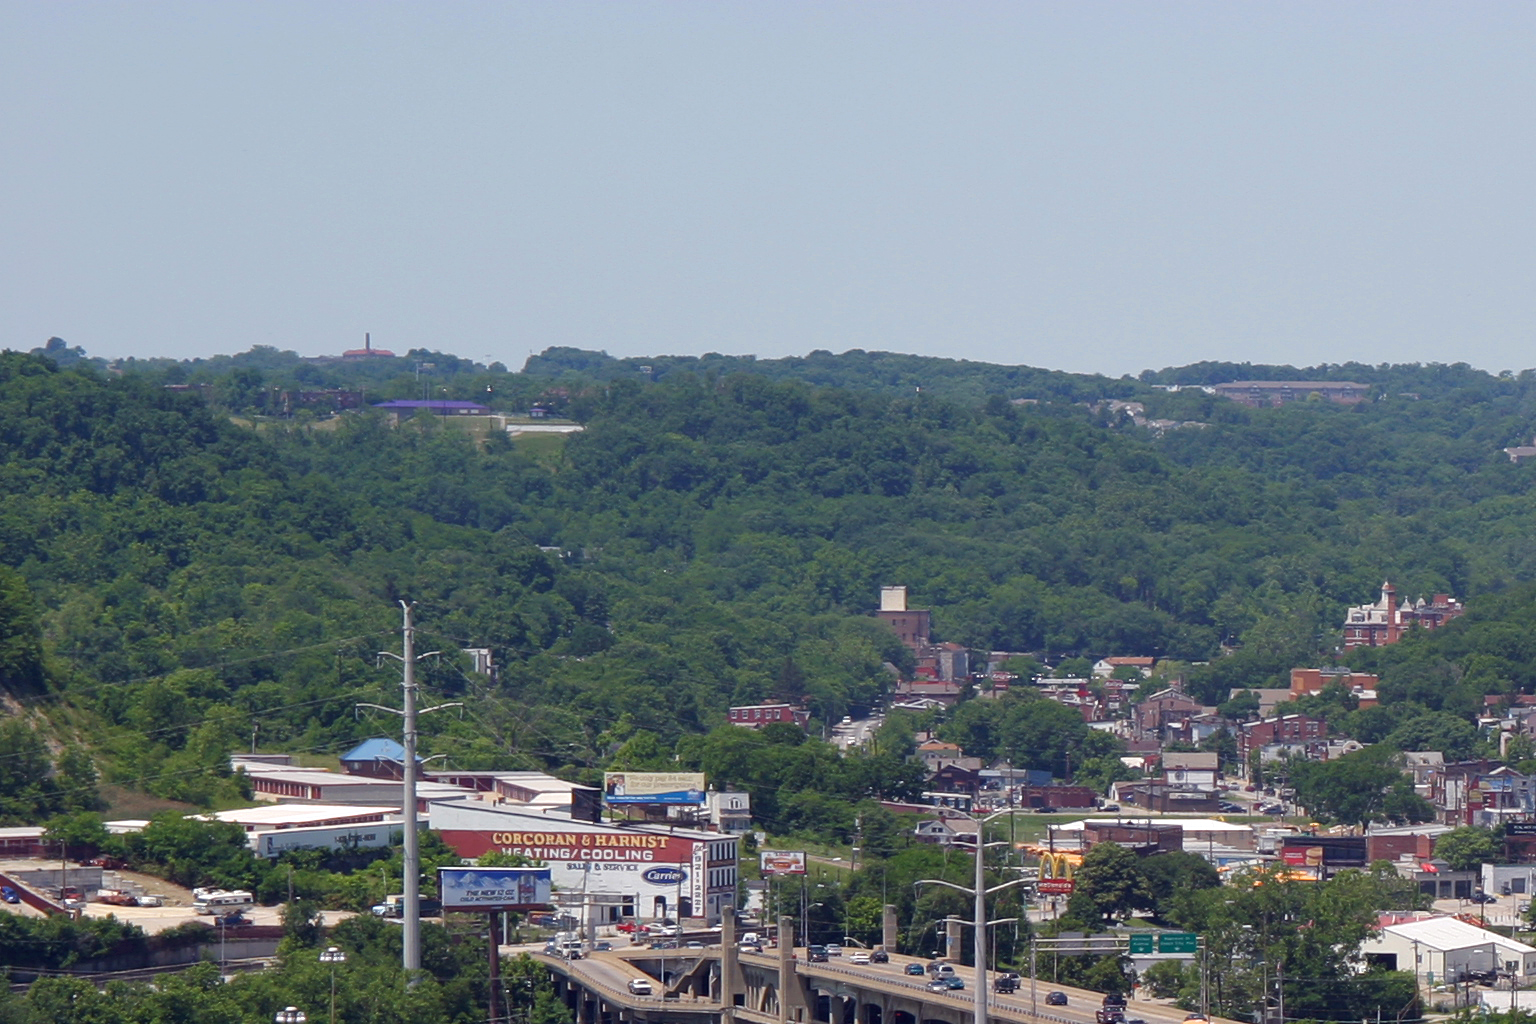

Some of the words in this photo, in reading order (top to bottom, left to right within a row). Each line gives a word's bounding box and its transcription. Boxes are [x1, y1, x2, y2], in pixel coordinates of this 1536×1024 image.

[492, 833, 576, 846] CORCORAN
[581, 835, 590, 846] &
[595, 835, 670, 848] HARNIST
[566, 863, 591, 871] SALE
[603, 864, 639, 872] SERVICE
